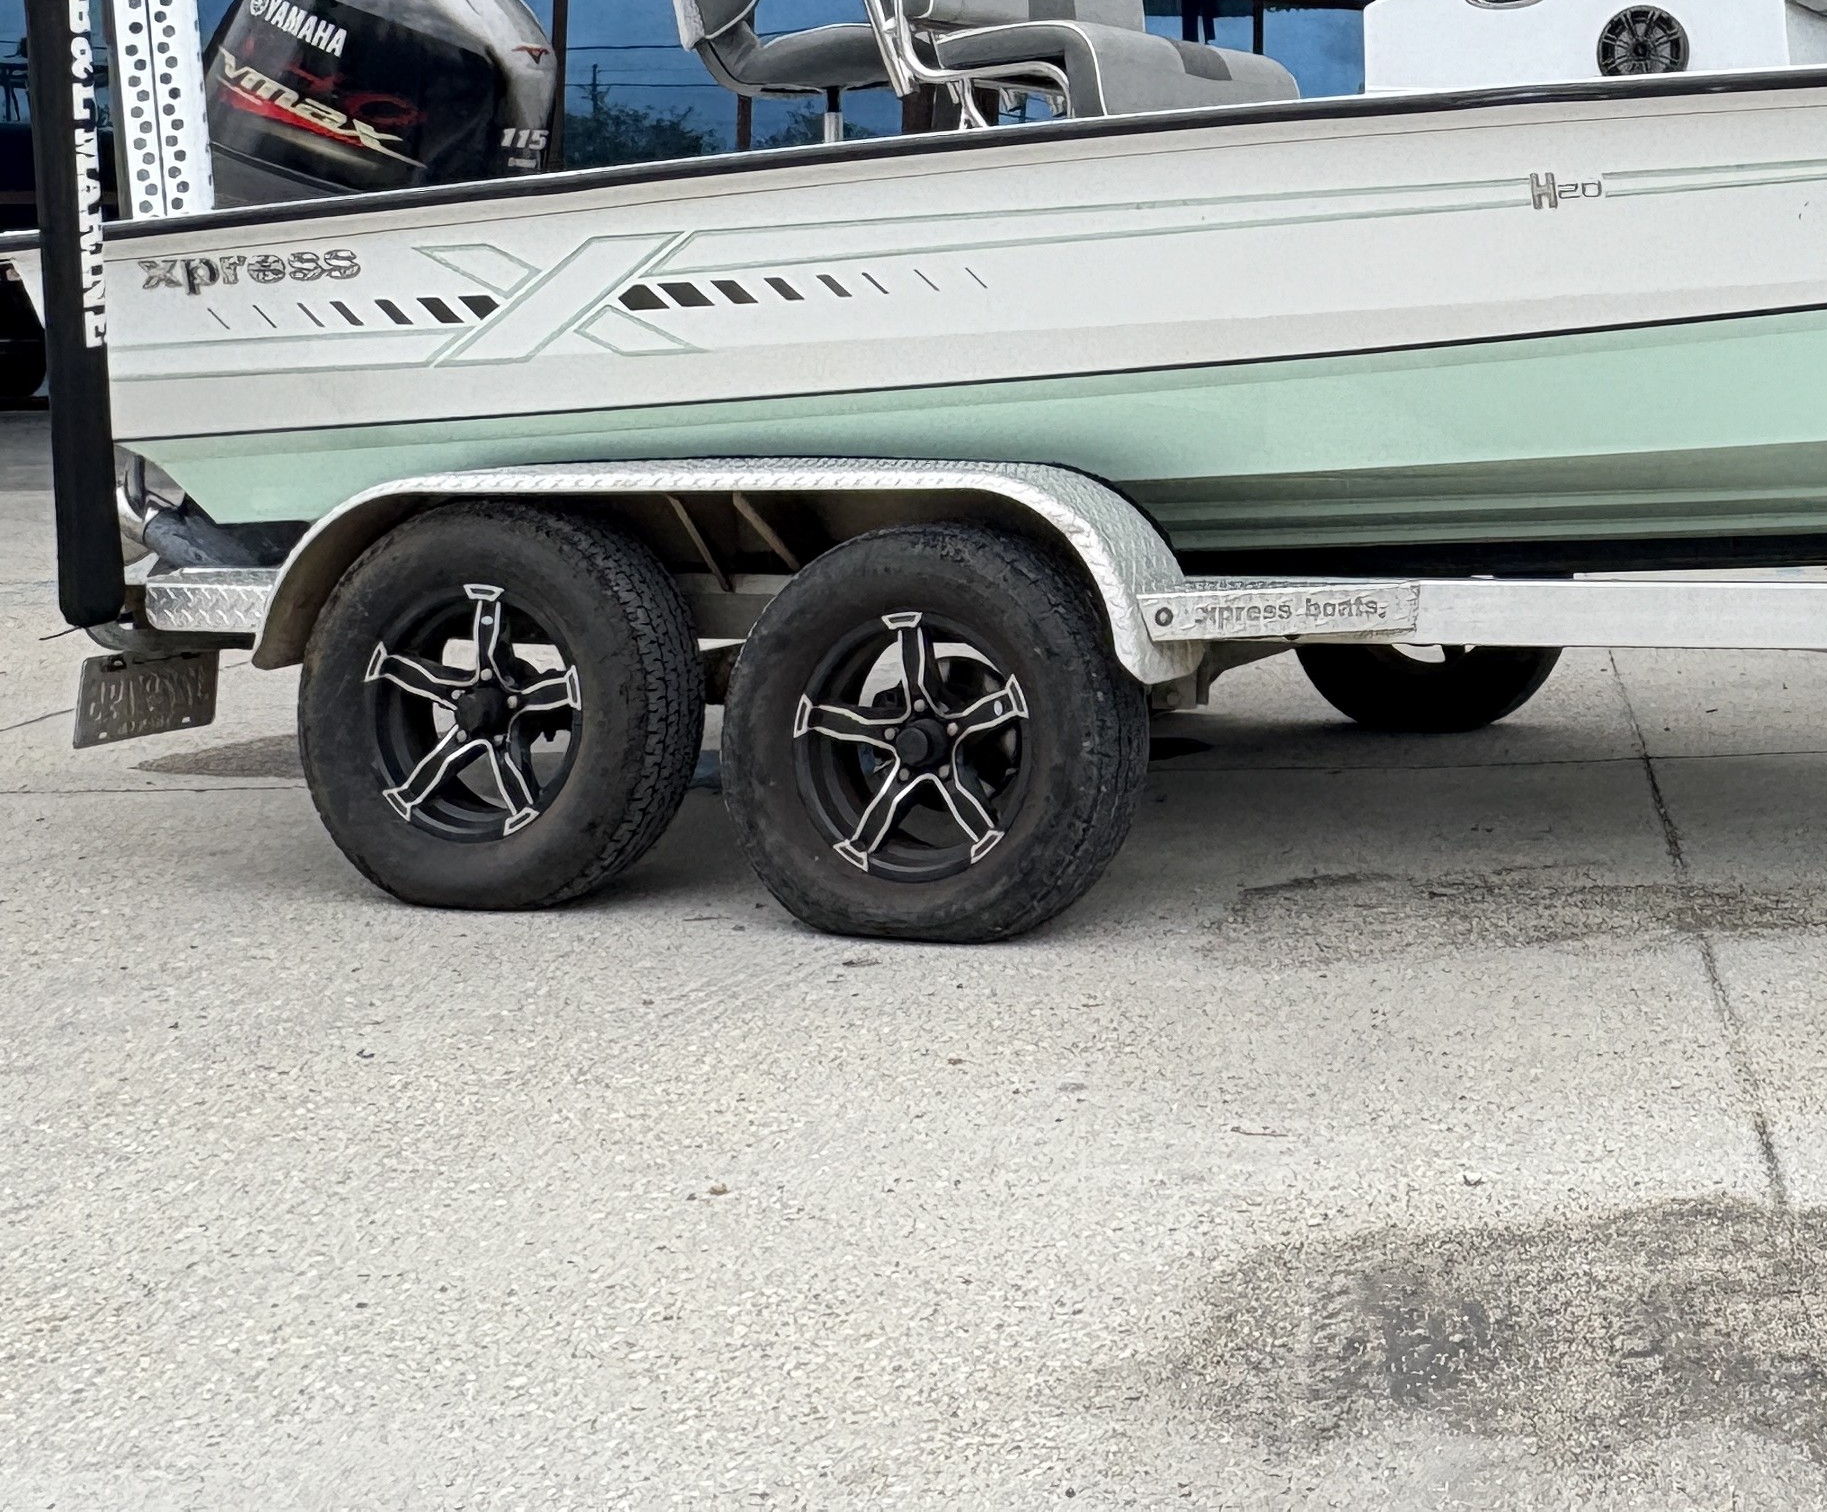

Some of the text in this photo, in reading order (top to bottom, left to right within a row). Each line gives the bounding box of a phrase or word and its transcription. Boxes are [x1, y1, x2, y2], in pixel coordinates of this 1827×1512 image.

[501, 127, 550, 151] 115
[137, 248, 362, 296] xpress
[1195, 603, 1293, 630] xpress
